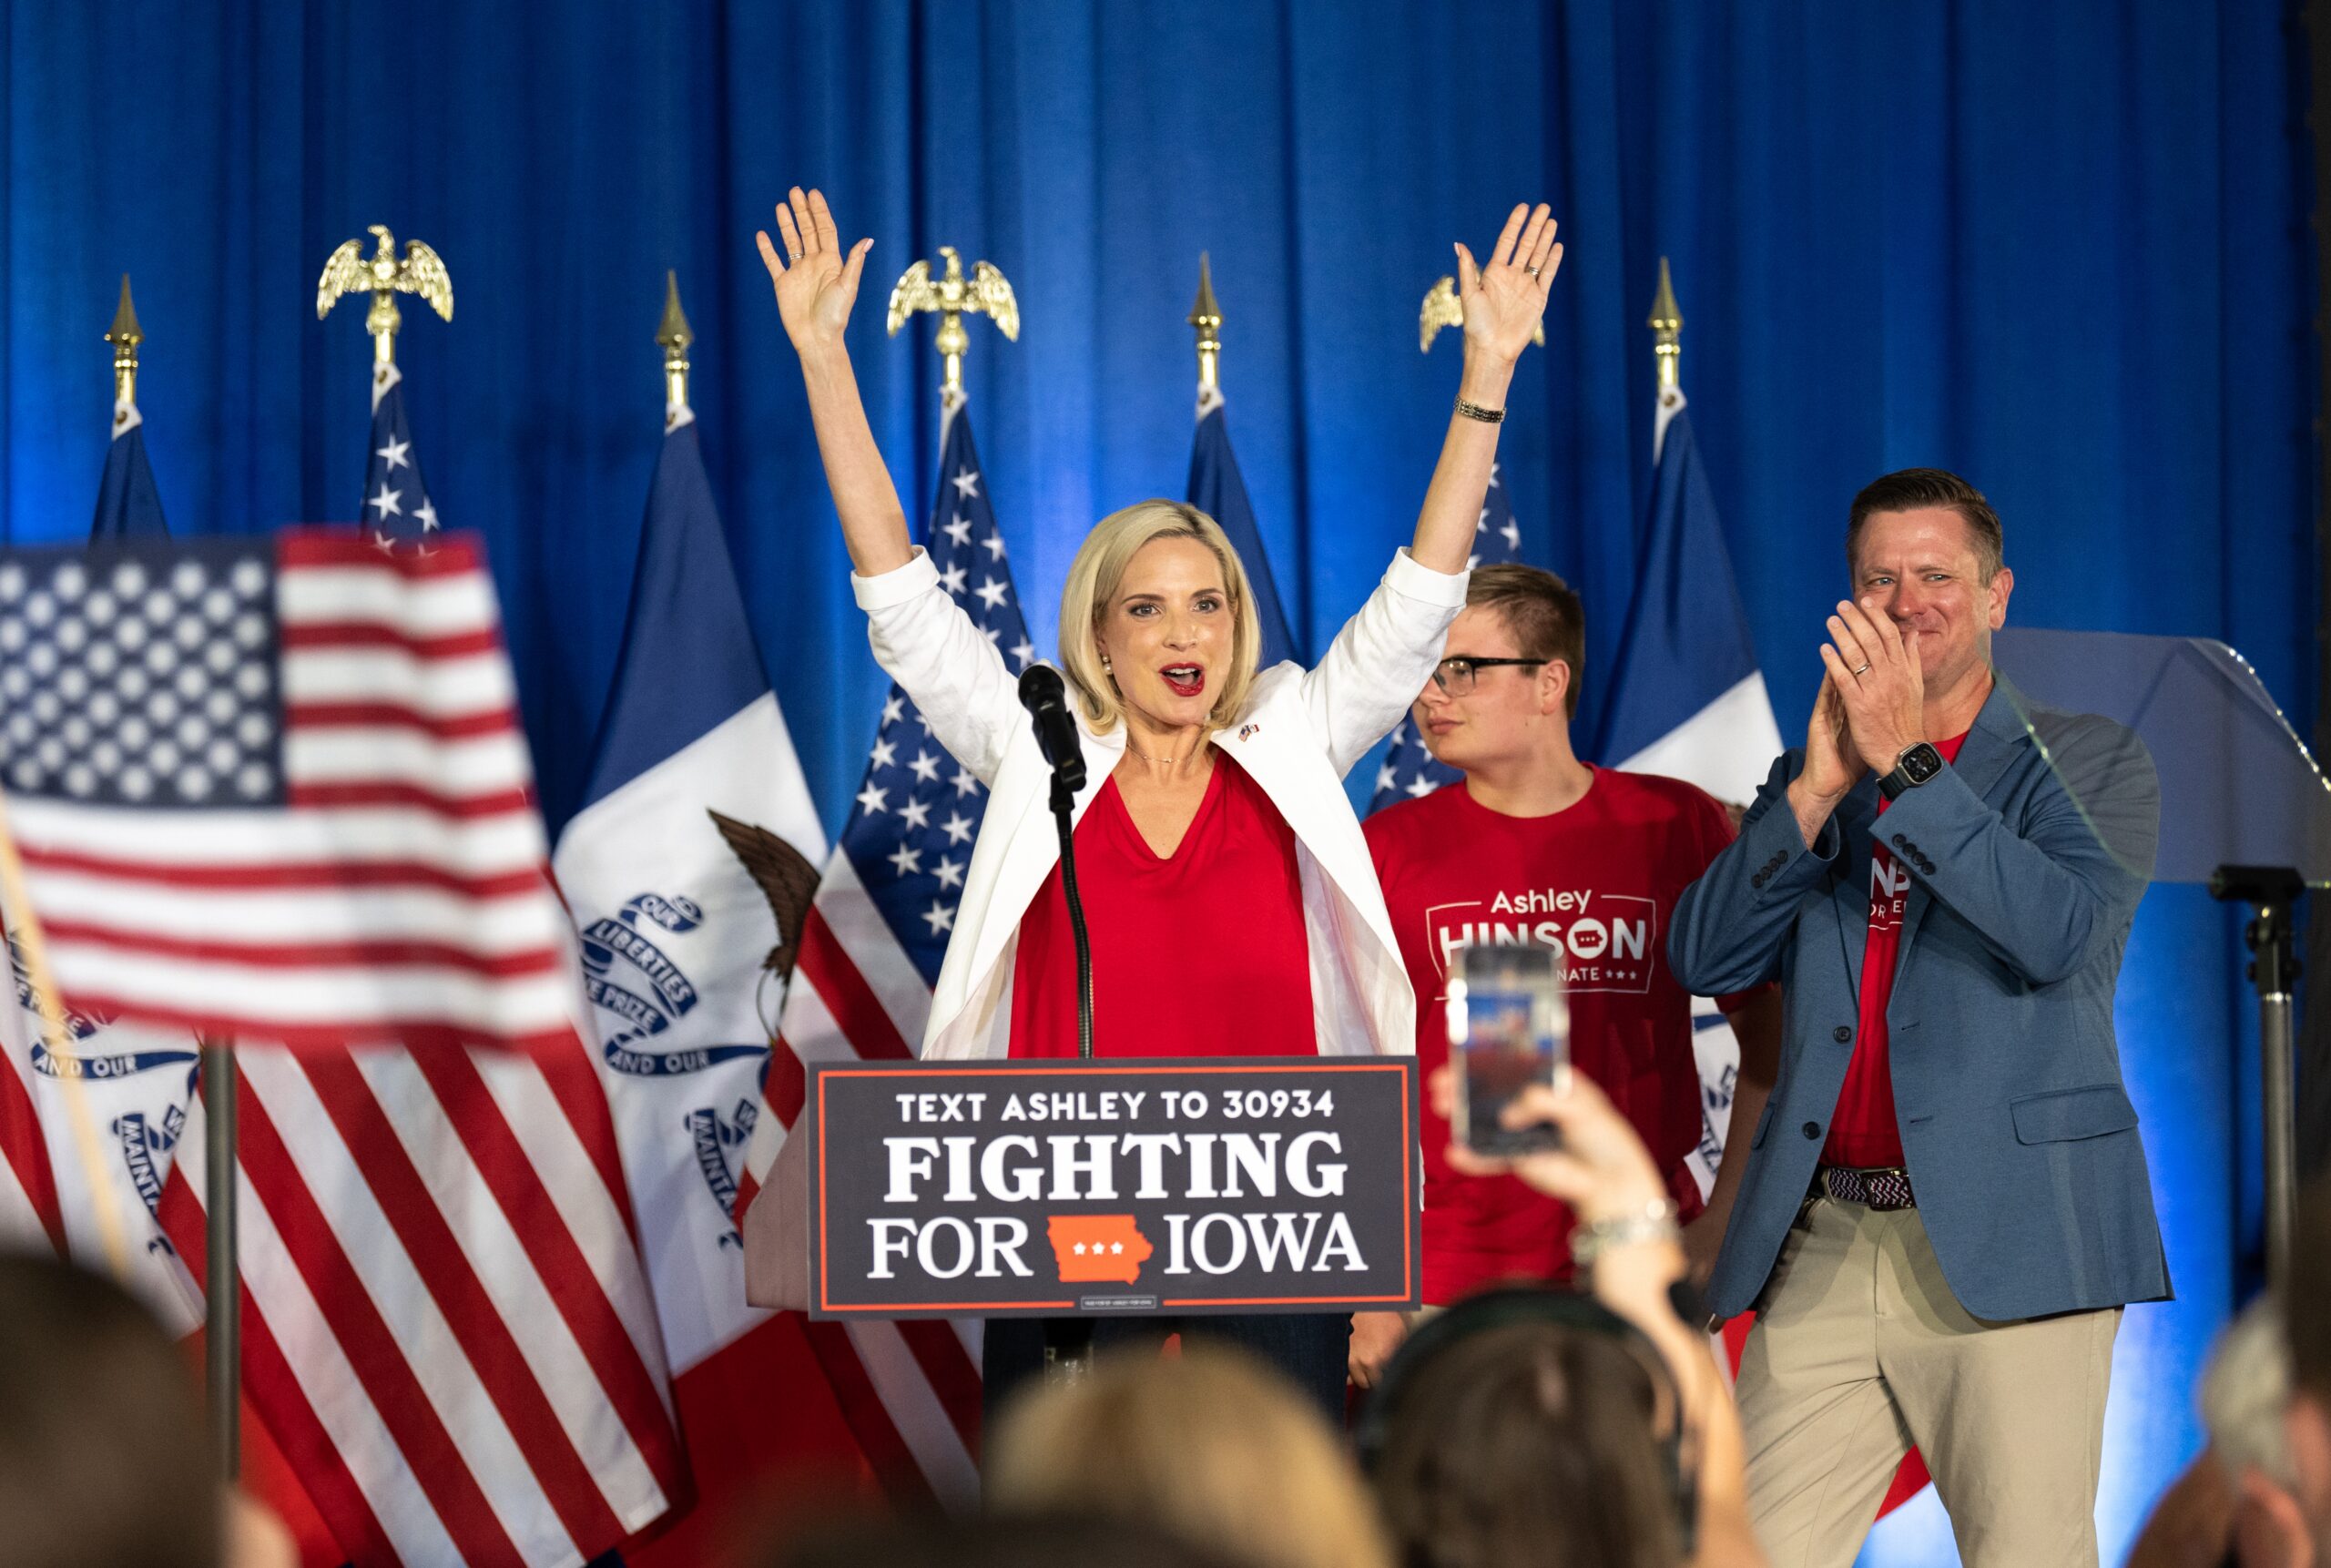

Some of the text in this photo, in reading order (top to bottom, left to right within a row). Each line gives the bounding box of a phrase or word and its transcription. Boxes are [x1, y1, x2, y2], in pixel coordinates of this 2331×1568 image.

[641, 896, 681, 931] OUR
[1491, 889, 1592, 914] Ashley
[594, 921, 693, 1003] LIBERTIES
[1556, 967, 1600, 982] NATE
[602, 984, 659, 1030] PRIZE
[34, 1054, 137, 1078] AND OUR
[606, 1050, 710, 1074] AND OUR
[896, 1090, 1335, 1122] TEXT ASHLEY TO 30934
[693, 1115, 737, 1213] MAINTA
[883, 1132, 1348, 1202] FIGHTING
[867, 1212, 1369, 1278] FOR IOWA
